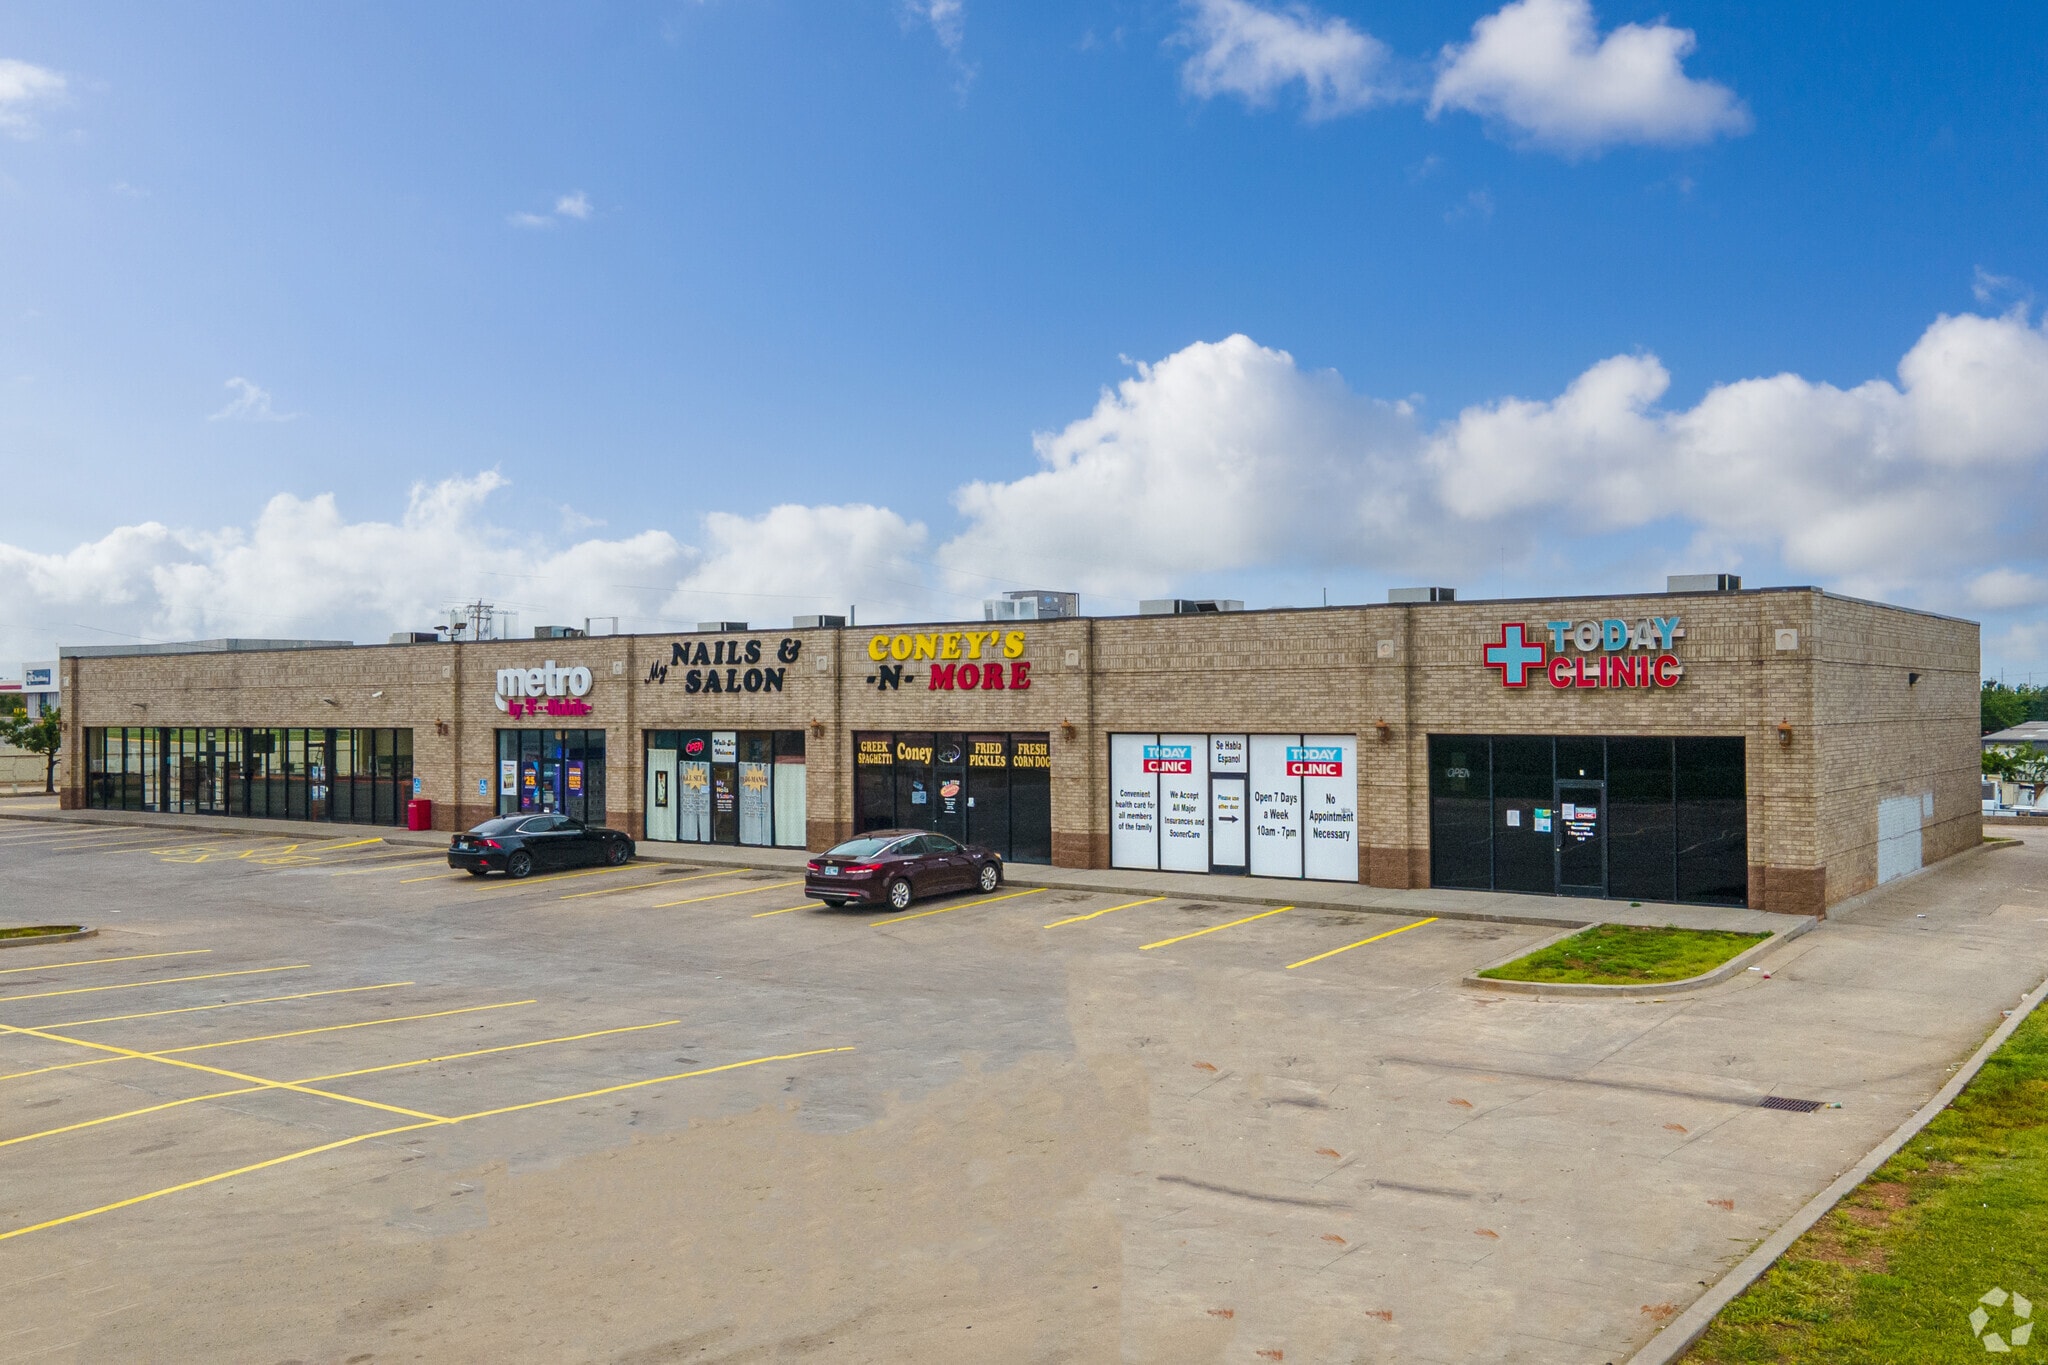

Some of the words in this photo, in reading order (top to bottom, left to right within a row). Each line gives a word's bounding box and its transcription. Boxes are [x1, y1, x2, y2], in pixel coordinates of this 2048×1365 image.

[1547, 617, 1681, 652] TODAY
[868, 630, 1025, 661] CONEY'S
[671, 640, 761, 666] NAILS
[777, 638, 802, 663] &
[644, 660, 668, 684] My
[928, 661, 1031, 690] MORE
[1547, 654, 1682, 689] CLINIC
[496, 660, 593, 697] metro
[685, 667, 786, 693] SALON
[508, 699, 524, 720] by
[687, 742, 704, 753] OPEN
[861, 741, 889, 753] GREEK
[975, 742, 1003, 754] FRIED
[1017, 743, 1048, 755] FRESH
[1216, 740, 1224, 750] Se
[1225, 740, 1242, 750] Habla
[897, 742, 933, 765] Coney
[1147, 747, 1187, 758] TODAY
[1291, 749, 1337, 760] TODAY
[858, 753, 893, 765] SPAGHETTI
[969, 755, 1006, 767] PICKLES
[1013, 755, 1035, 768] CORN
[1148, 761, 1187, 772] CLINIC
[1292, 763, 1337, 775] CLINIC
[1447, 767, 1470, 778] OPEN
[1120, 789, 1151, 798] Convenient
[1170, 791, 1178, 799] We
[1180, 791, 1199, 801] Accept
[1254, 791, 1272, 804] Open
[1274, 792, 1278, 802] 7
[1280, 792, 1297, 805] Days
[1326, 793, 1335, 804] No
[1115, 801, 1132, 809] health
[1147, 801, 1155, 809] for
[1181, 804, 1196, 814] Major
[1127, 812, 1152, 820] members
[1263, 811, 1268, 819] a
[1269, 808, 1289, 820] Week
[1309, 810, 1353, 825] Appointment
[1164, 817, 1193, 825] Insurances
[1195, 818, 1205, 826] and
[1136, 823, 1152, 833] family
[1169, 829, 1200, 839] SoonerCare
[1257, 825, 1275, 836] 10am
[1282, 826, 1296, 839] 7pm
[1313, 827, 1350, 841] Necessary
